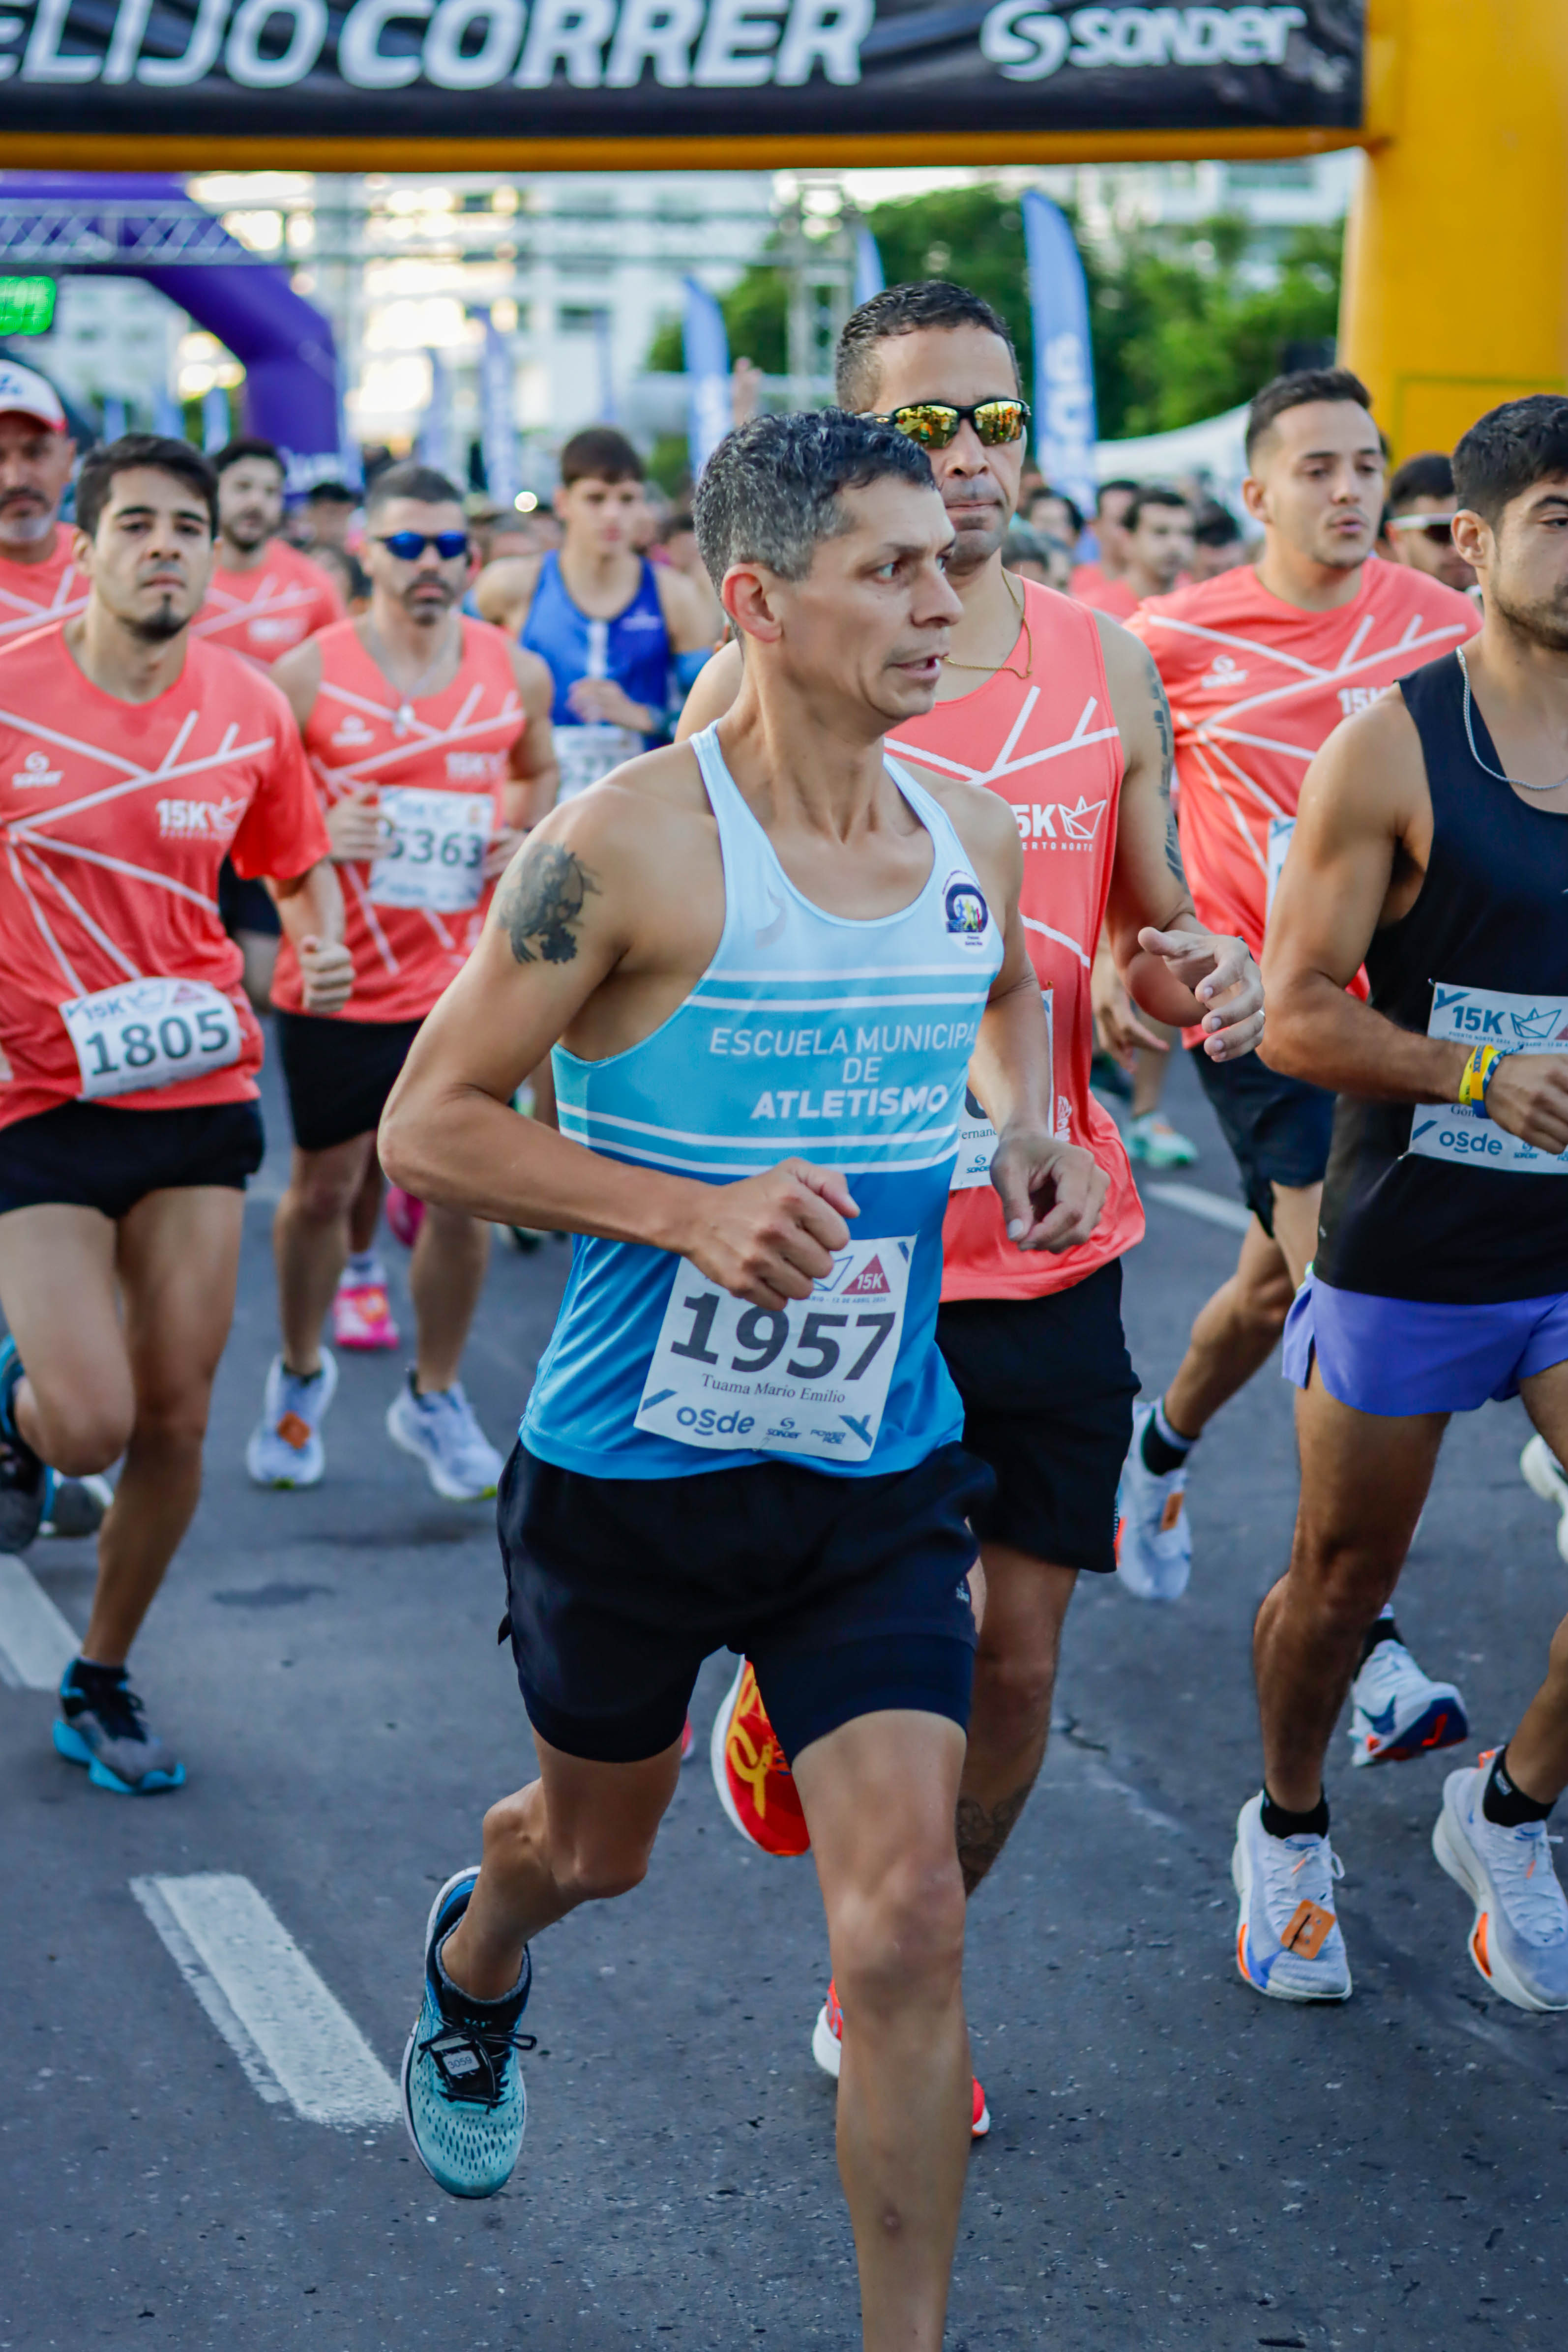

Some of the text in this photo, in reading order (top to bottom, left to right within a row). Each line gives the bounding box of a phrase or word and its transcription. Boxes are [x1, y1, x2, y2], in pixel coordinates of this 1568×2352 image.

[338, 0, 875, 90] CORRER
[155, 799, 207, 828] 15K
[1010, 804, 1057, 838] 5K
[1022, 841, 1056, 851] ERTO
[1452, 1005, 1505, 1034] 15K
[85, 1008, 230, 1076] 1805
[710, 1022, 976, 1056] ESCUELA MUNICIPA
[842, 1057, 882, 1083] DE
[750, 1085, 949, 1119] ATLETISMO
[959, 1128, 997, 1139] ernan
[1439, 1131, 1503, 1155] osde
[858, 1272, 884, 1290] 15K
[670, 1292, 896, 1380] 1957
[702, 1374, 845, 1403] Tuama Mario Emilio
[677, 1406, 755, 1436] osde
[447, 2056, 472, 2069] 3059
